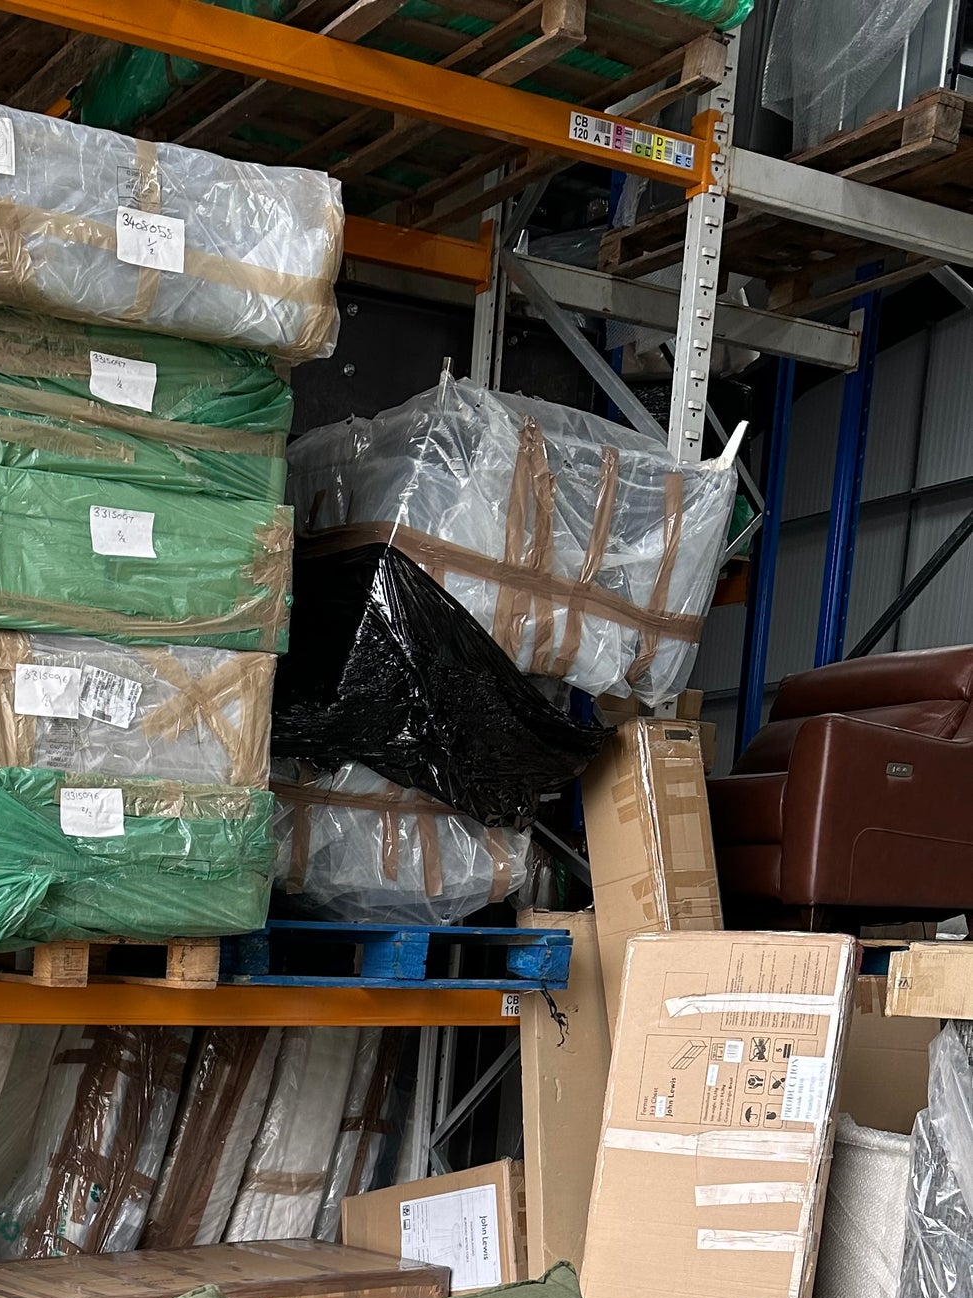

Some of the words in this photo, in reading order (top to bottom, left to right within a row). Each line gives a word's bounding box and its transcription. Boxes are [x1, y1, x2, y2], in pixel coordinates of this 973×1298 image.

[574, 115, 588, 127] CB
[573, 127, 589, 139] 120
[616, 126, 623, 135] B
[593, 134, 601, 143] A
[657, 137, 663, 146] D
[635, 145, 642, 153] C
[675, 155, 681, 164] E
[506, 995, 519, 1005] CB
[505, 1006, 520, 1015] 116
[667, 1077, 676, 1098] Lewis
[784, 1058, 798, 1118] PRODUCTION
[665, 1100, 674, 1117] John
[479, 1215, 489, 1235] John
[481, 1236, 489, 1260] Lewis
